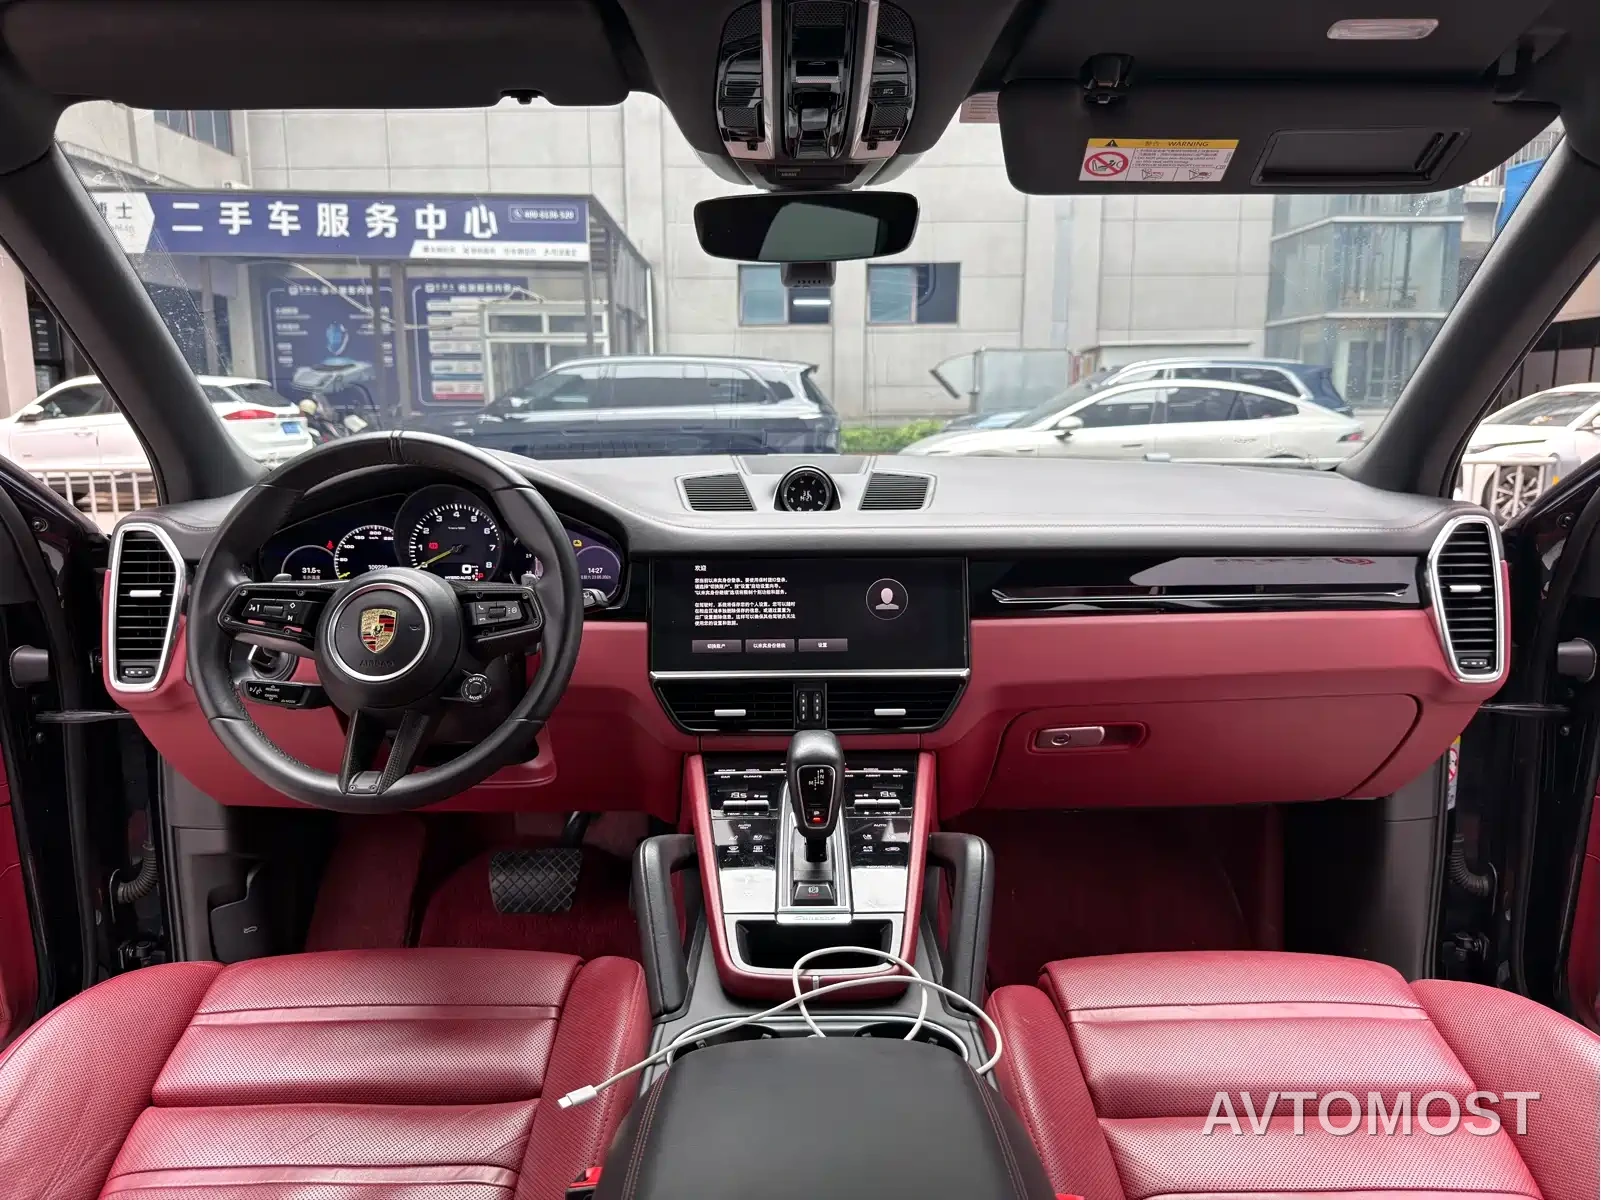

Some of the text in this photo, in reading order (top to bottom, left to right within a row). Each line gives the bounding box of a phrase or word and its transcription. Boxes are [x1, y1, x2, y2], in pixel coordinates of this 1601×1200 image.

[171, 200, 499, 240] 二手车服务中心
[461, 564, 472, 574] 0
